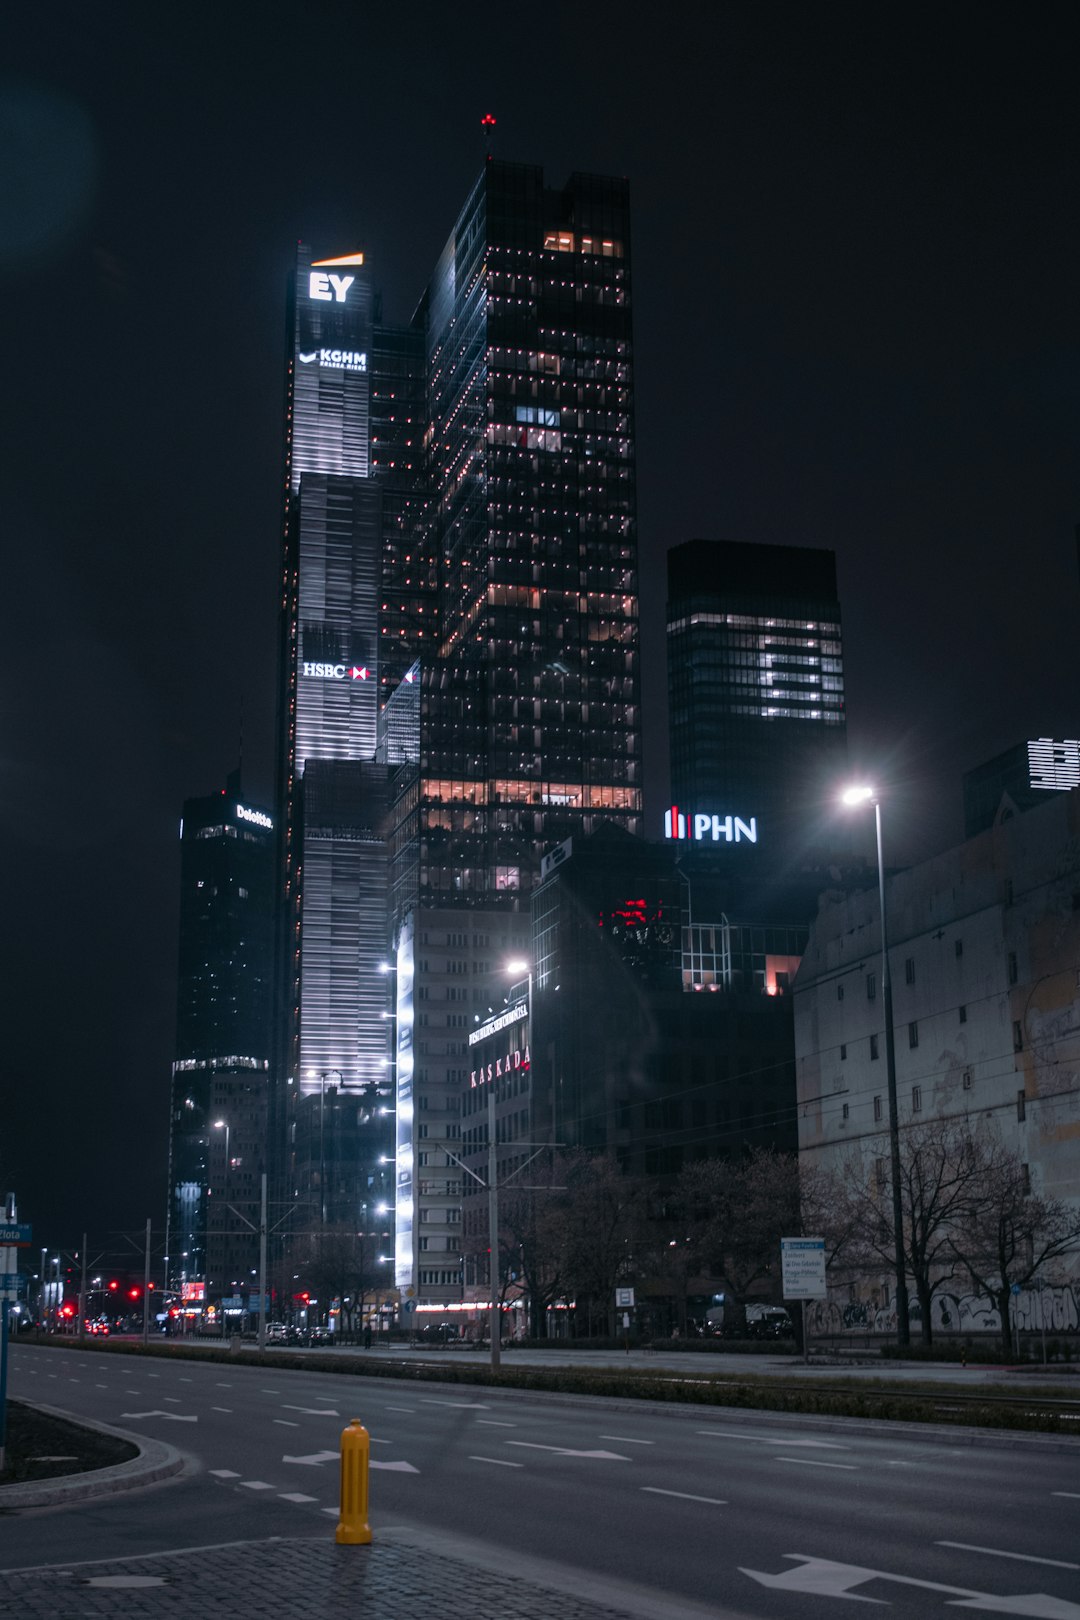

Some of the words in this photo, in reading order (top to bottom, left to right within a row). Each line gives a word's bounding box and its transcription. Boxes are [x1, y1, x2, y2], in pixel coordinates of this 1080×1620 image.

[309, 272, 355, 302] EY
[320, 348, 366, 365] KGHM
[303, 662, 346, 679] HSBC
[694, 813, 757, 843] PHN
[470, 1045, 531, 1089] KASKADA
